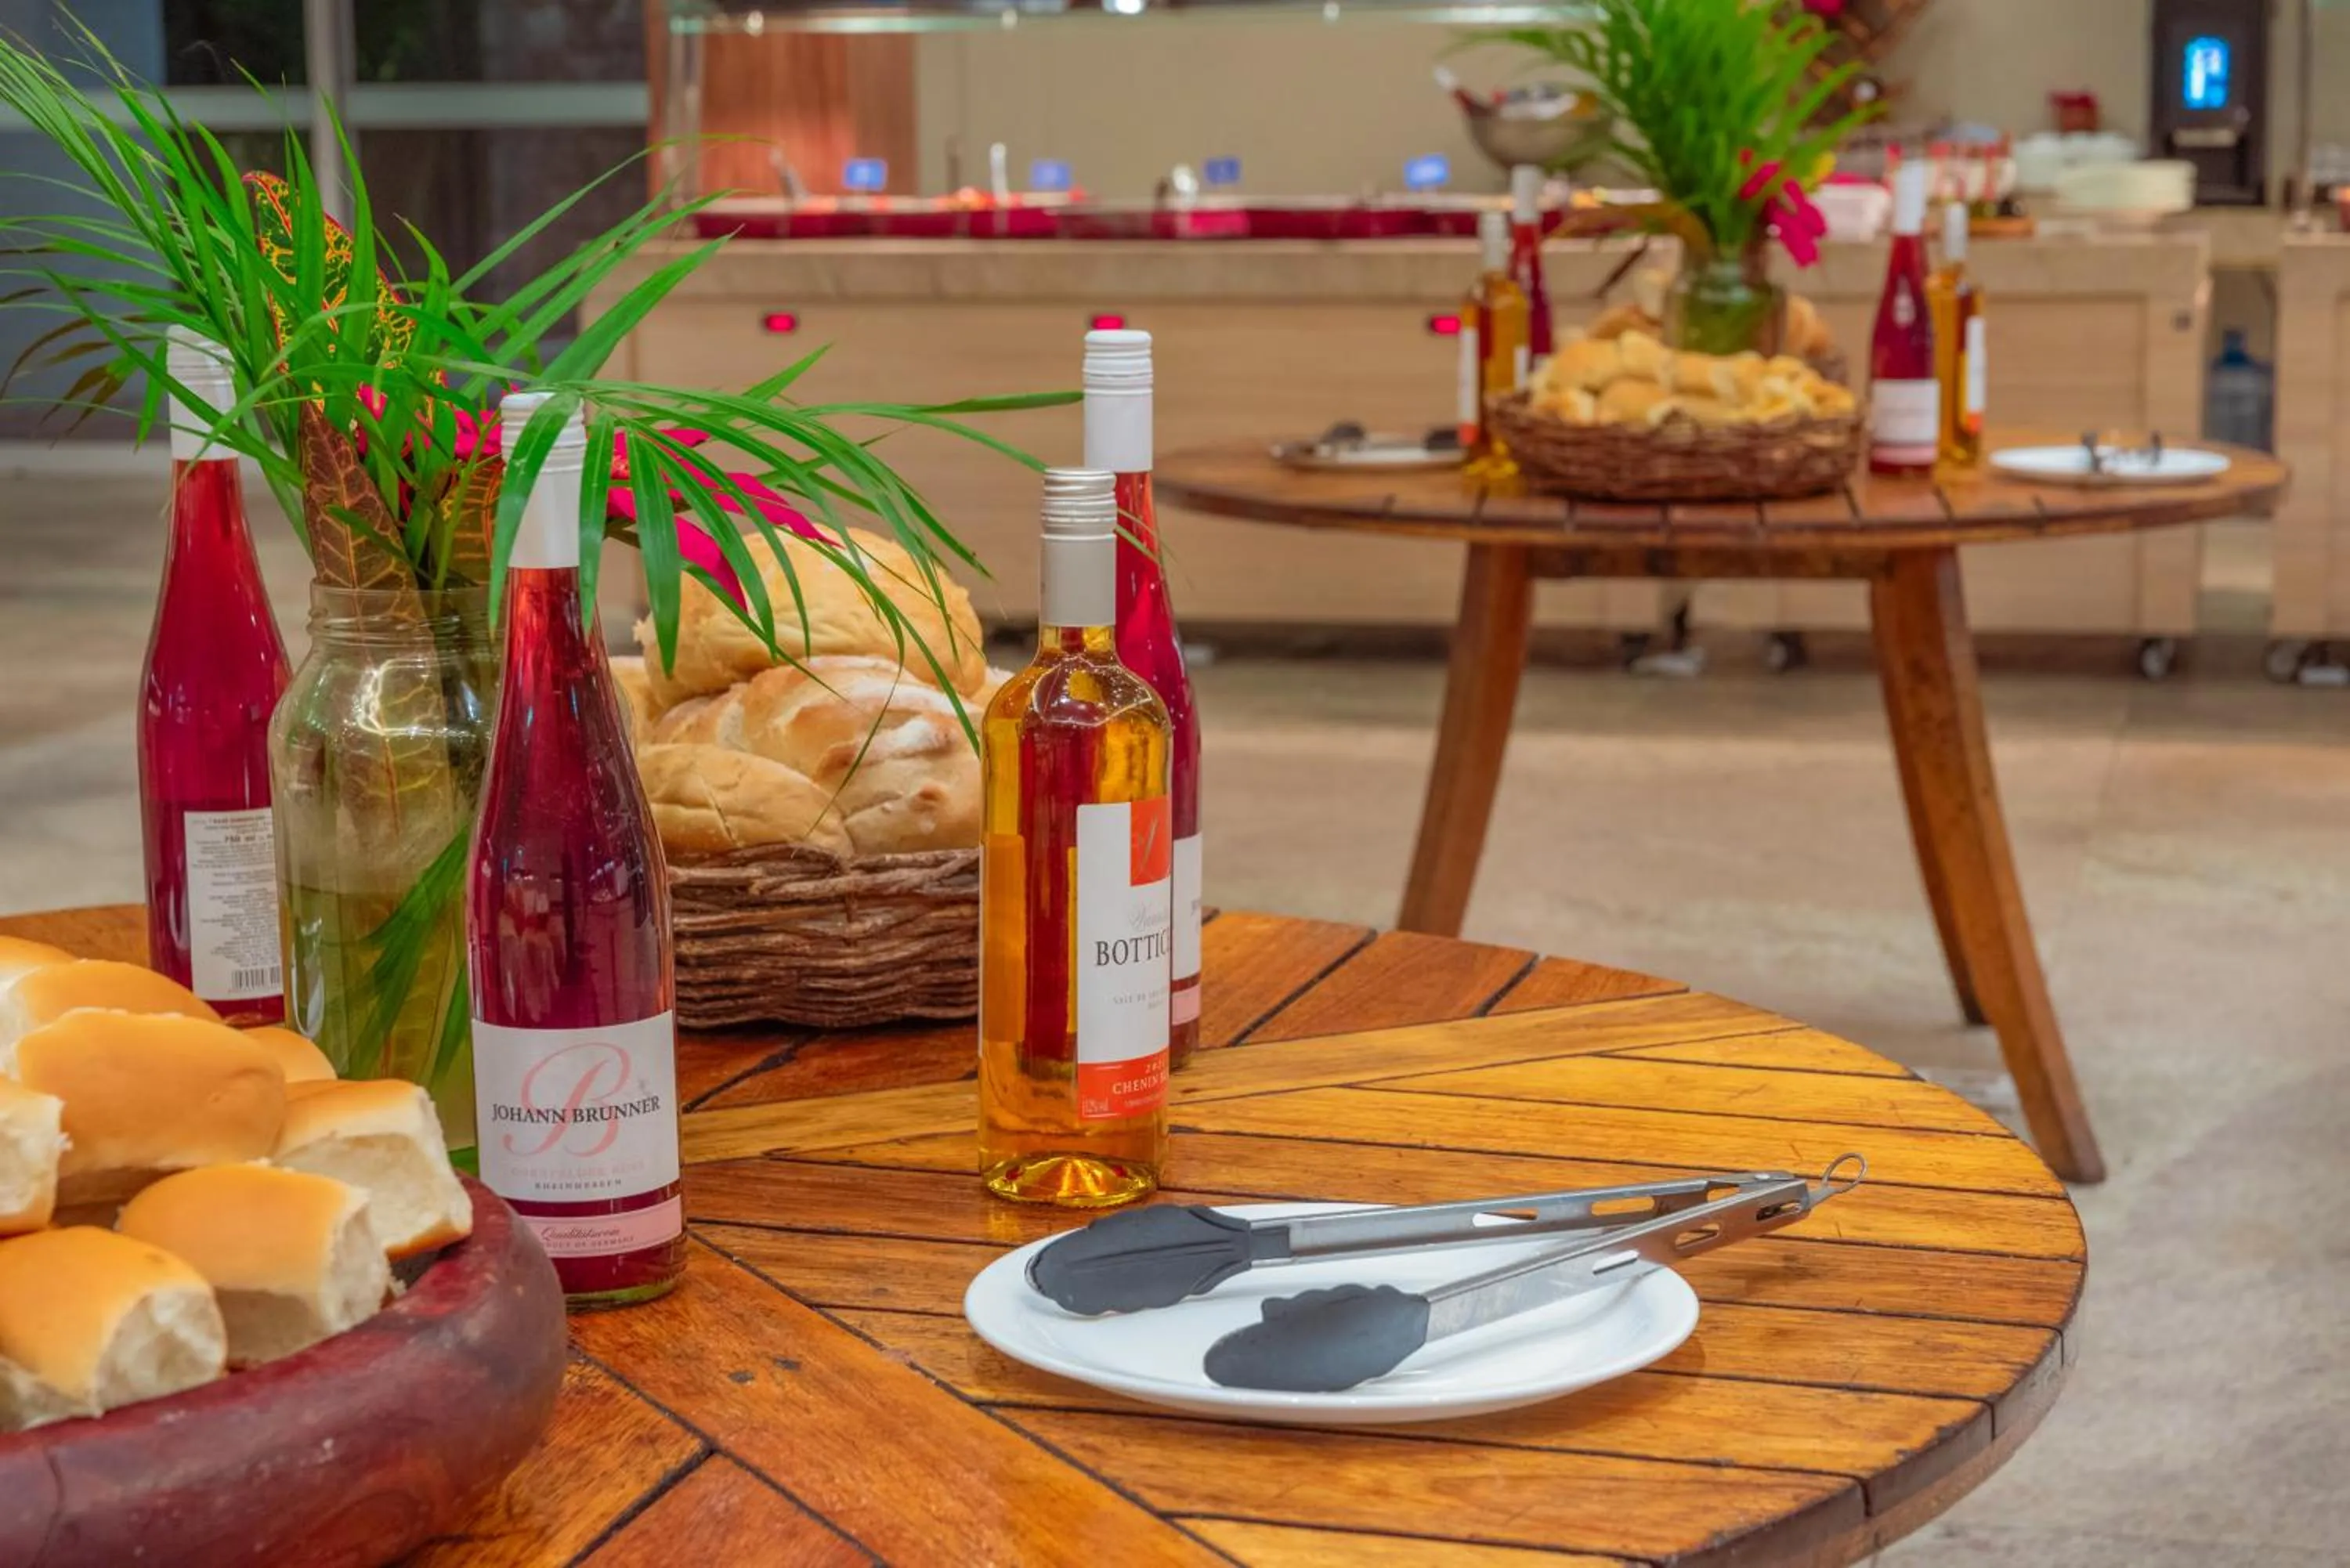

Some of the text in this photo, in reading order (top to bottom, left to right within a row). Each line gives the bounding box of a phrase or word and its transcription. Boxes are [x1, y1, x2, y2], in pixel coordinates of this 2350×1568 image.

[1094, 927, 1168, 966] BOTTIC
[492, 1096, 661, 1124] JOHANN BRUNNER
